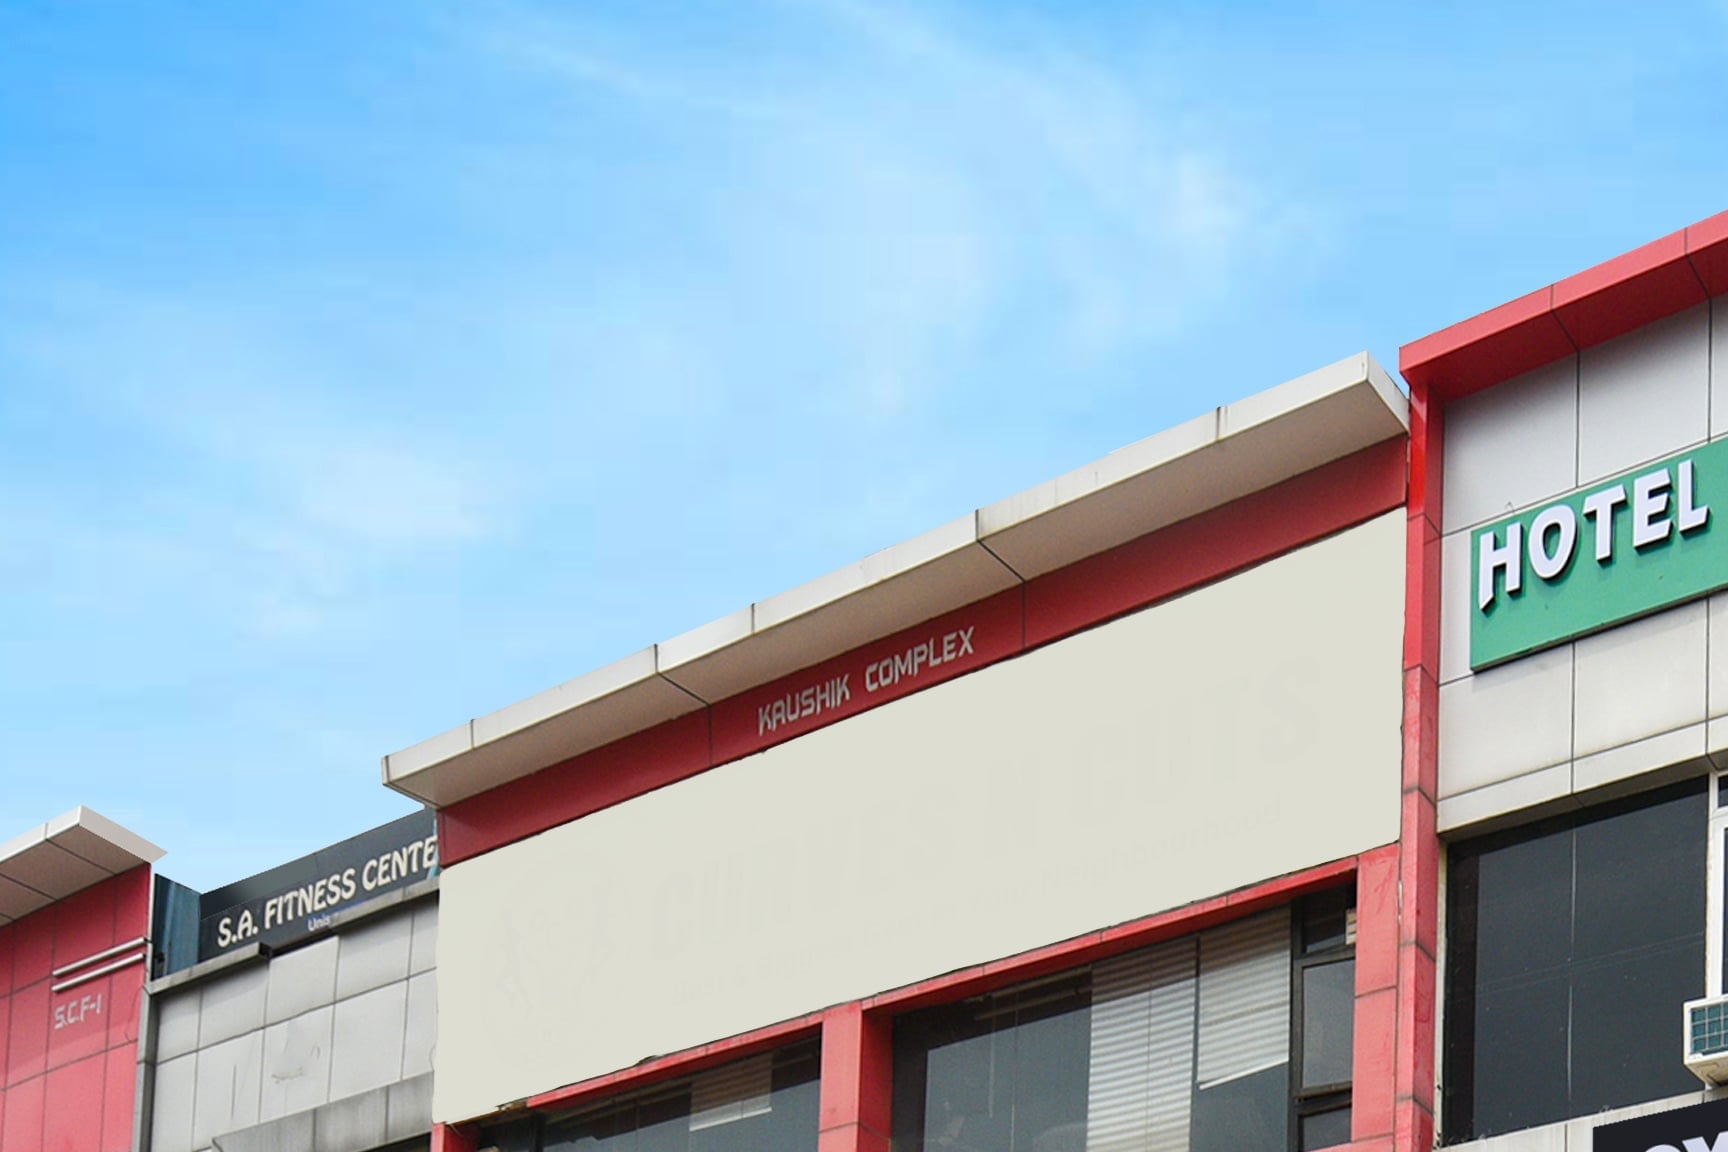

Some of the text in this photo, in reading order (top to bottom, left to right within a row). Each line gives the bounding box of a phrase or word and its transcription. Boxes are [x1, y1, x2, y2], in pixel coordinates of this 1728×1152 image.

[1478, 458, 1709, 613] HOTEL
[758, 626, 974, 735] KAUSHIK COMPLEX
[217, 909, 258, 949] S.A.
[264, 873, 357, 930] FITNESS
